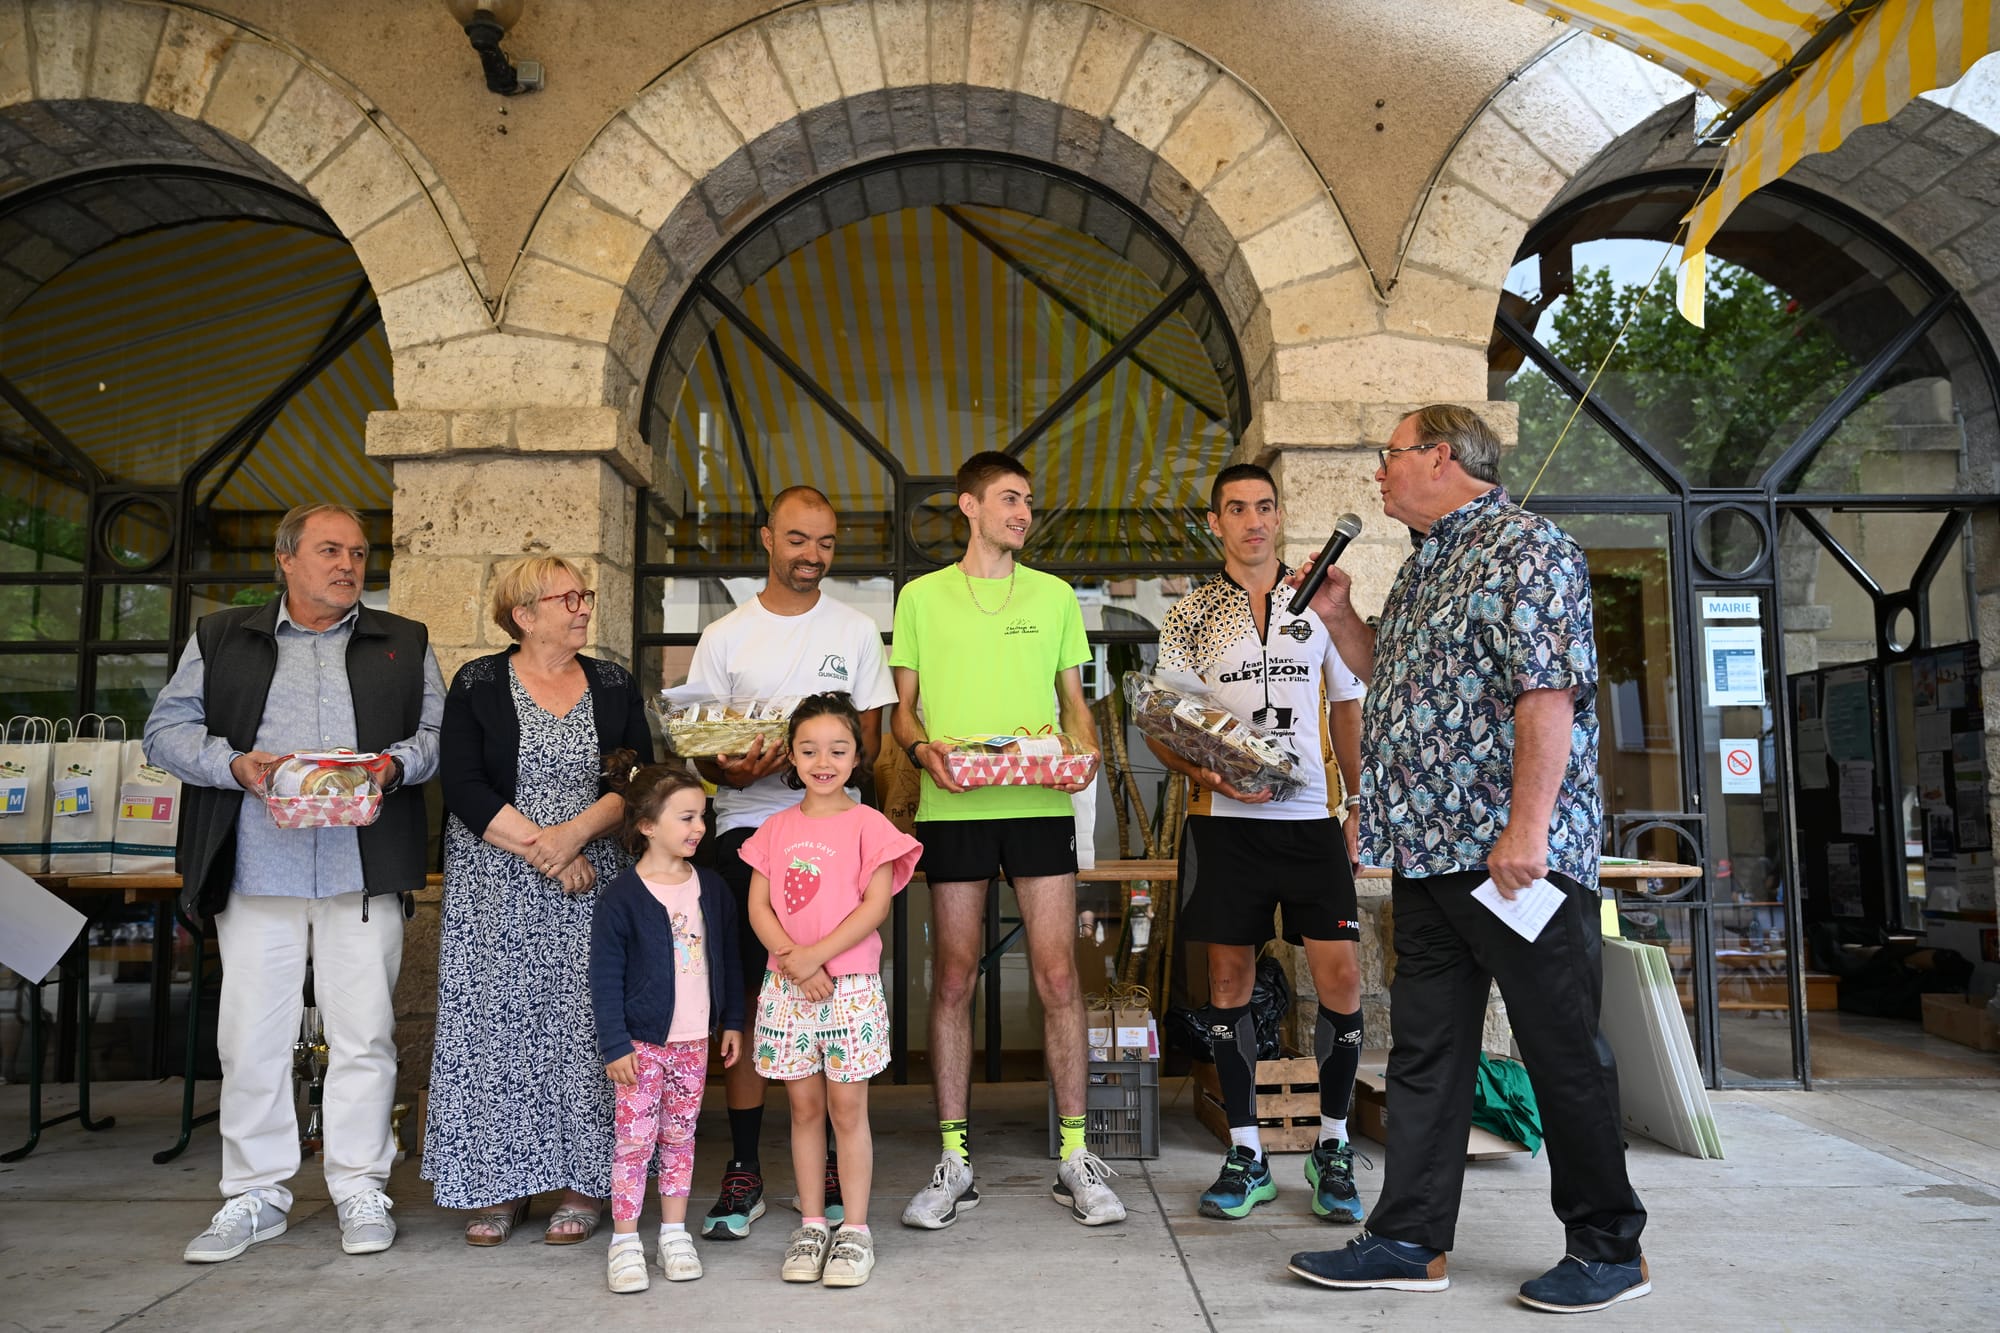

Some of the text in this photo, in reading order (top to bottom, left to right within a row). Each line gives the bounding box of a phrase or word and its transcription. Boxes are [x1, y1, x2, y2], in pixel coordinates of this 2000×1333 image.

[1709, 602, 1752, 613] MAIRIE
[1239, 656, 1294, 672] Jean Marc
[9, 794, 22, 806] M
[59, 800, 65, 812] 1
[78, 794, 87, 806] M
[126, 805, 134, 818] 1
[158, 803, 167, 816] F
[816, 842, 837, 857] DAYS
